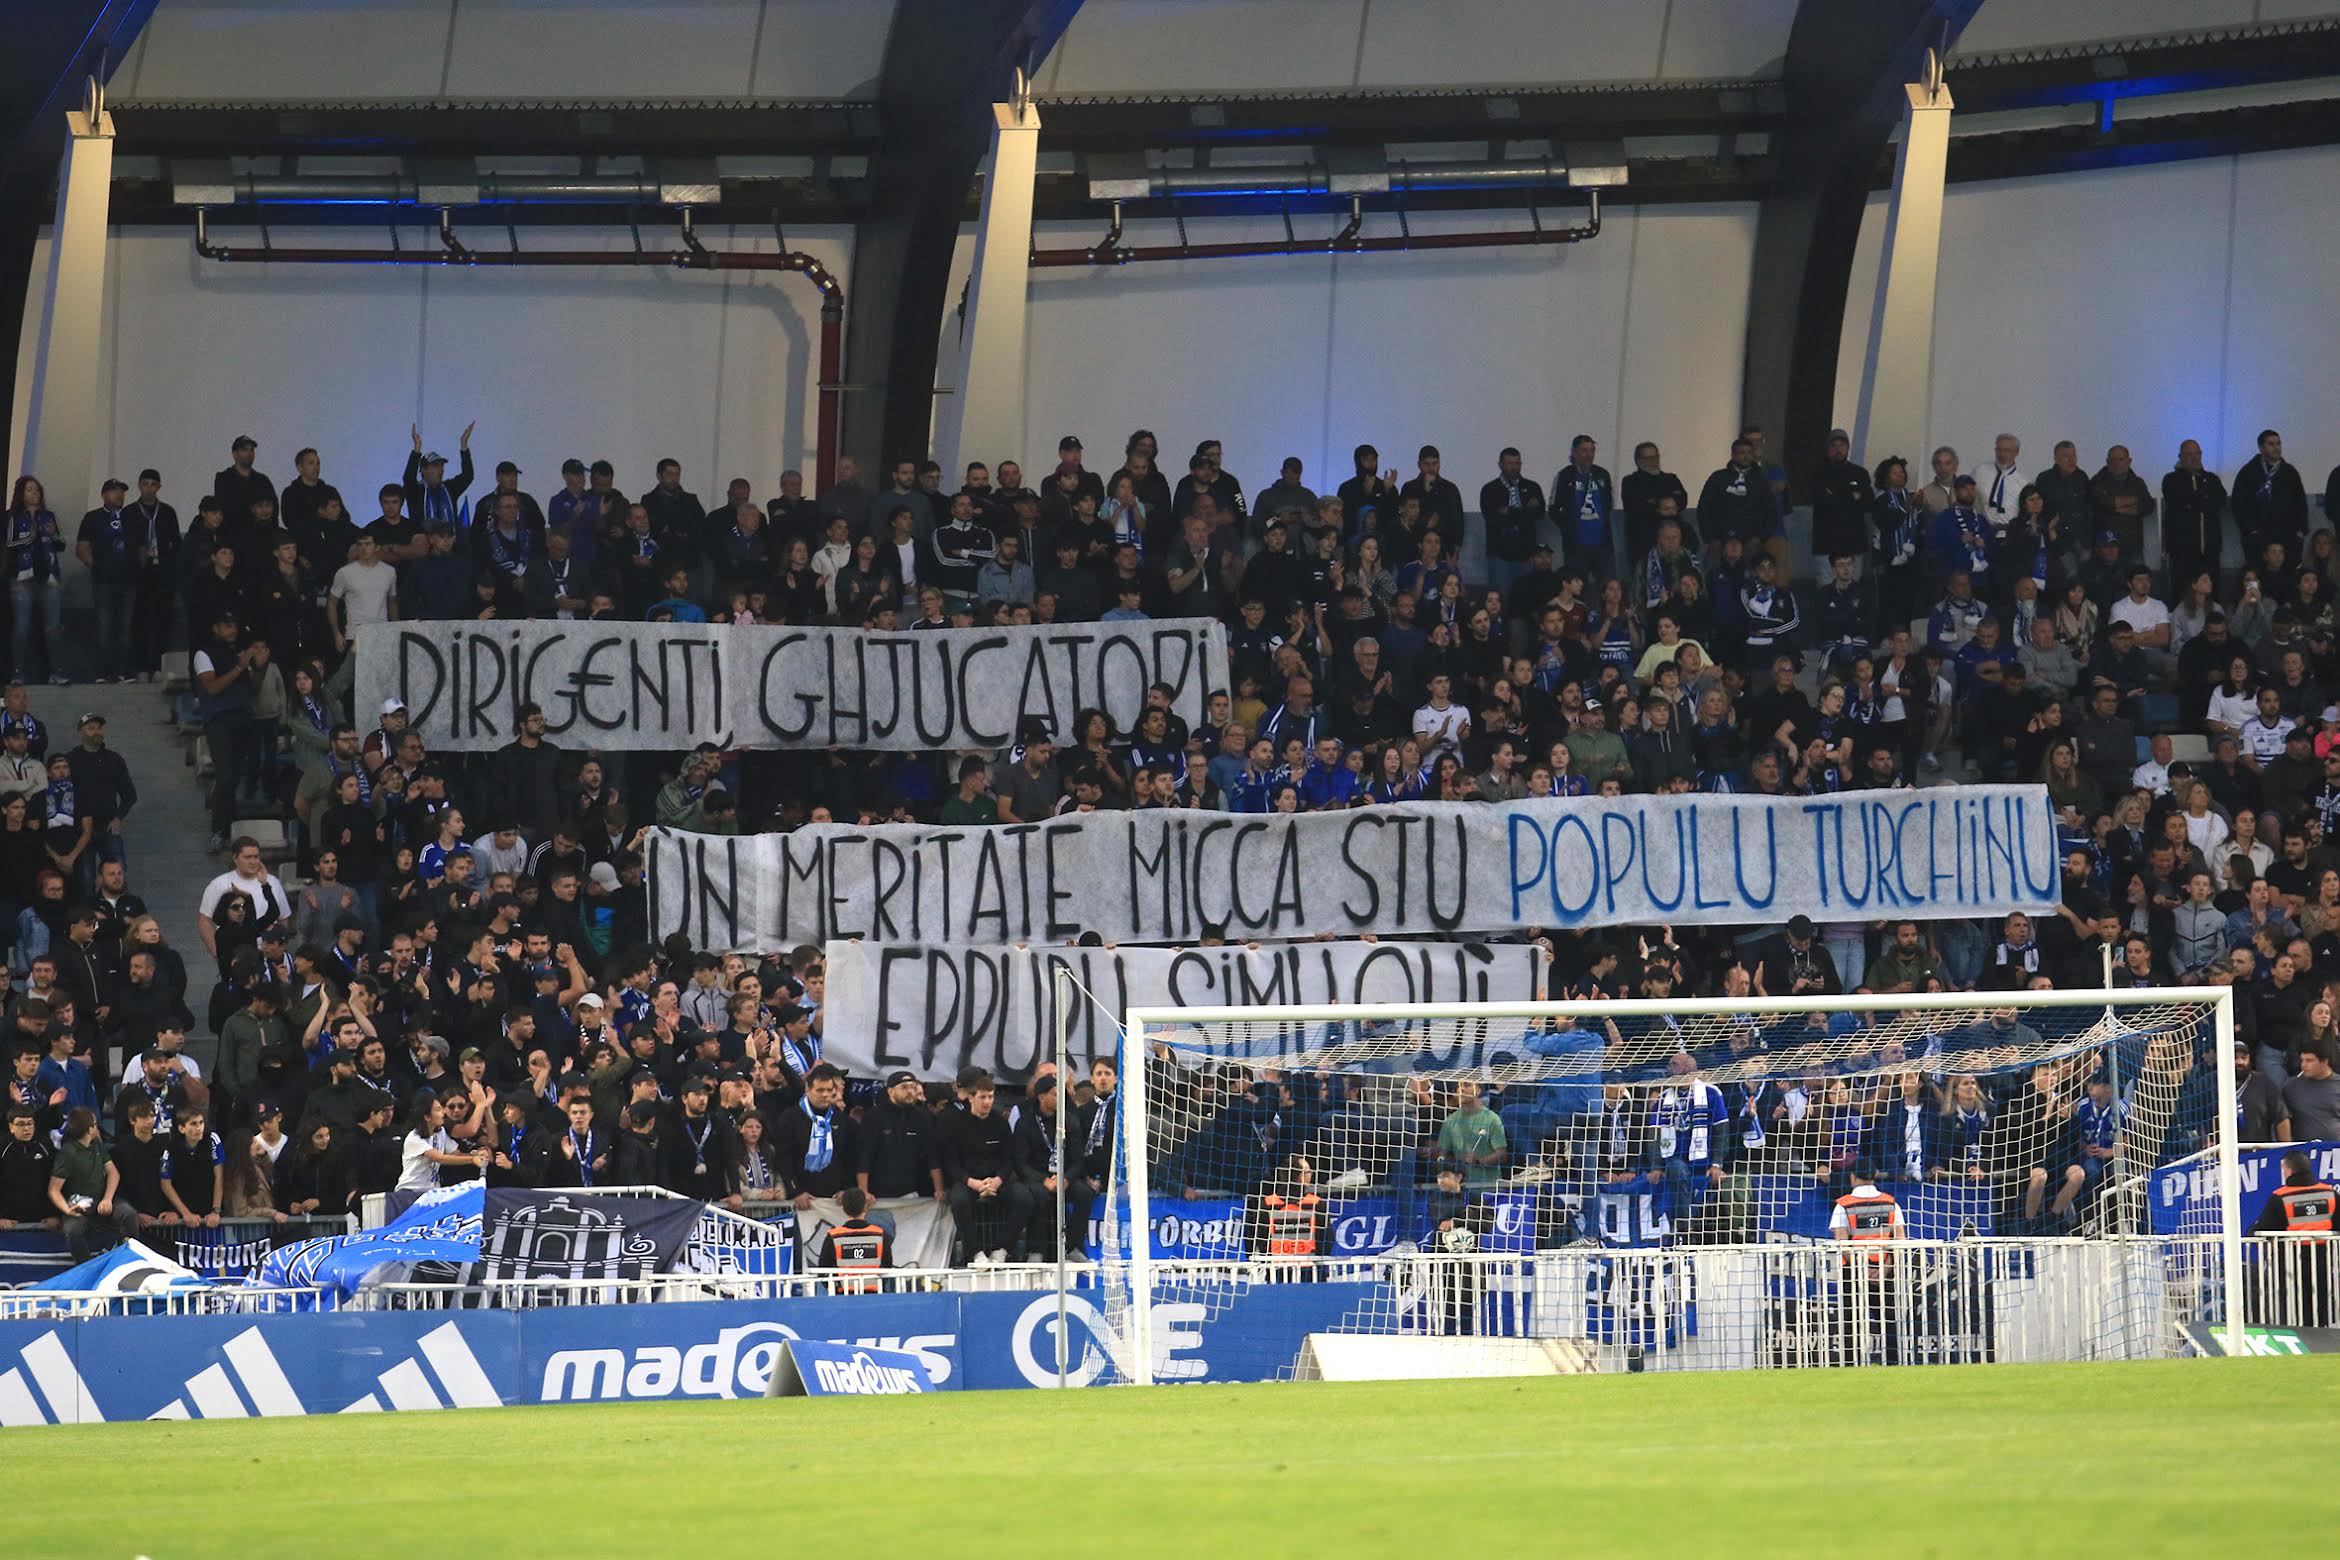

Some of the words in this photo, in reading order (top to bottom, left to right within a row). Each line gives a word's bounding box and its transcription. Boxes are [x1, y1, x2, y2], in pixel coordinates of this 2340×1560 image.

[1341, 813, 1468, 930] STU
[1507, 805, 1779, 922] POPULU
[2305, 1205, 2317, 1216] 30
[853, 1248, 864, 1259] 02
